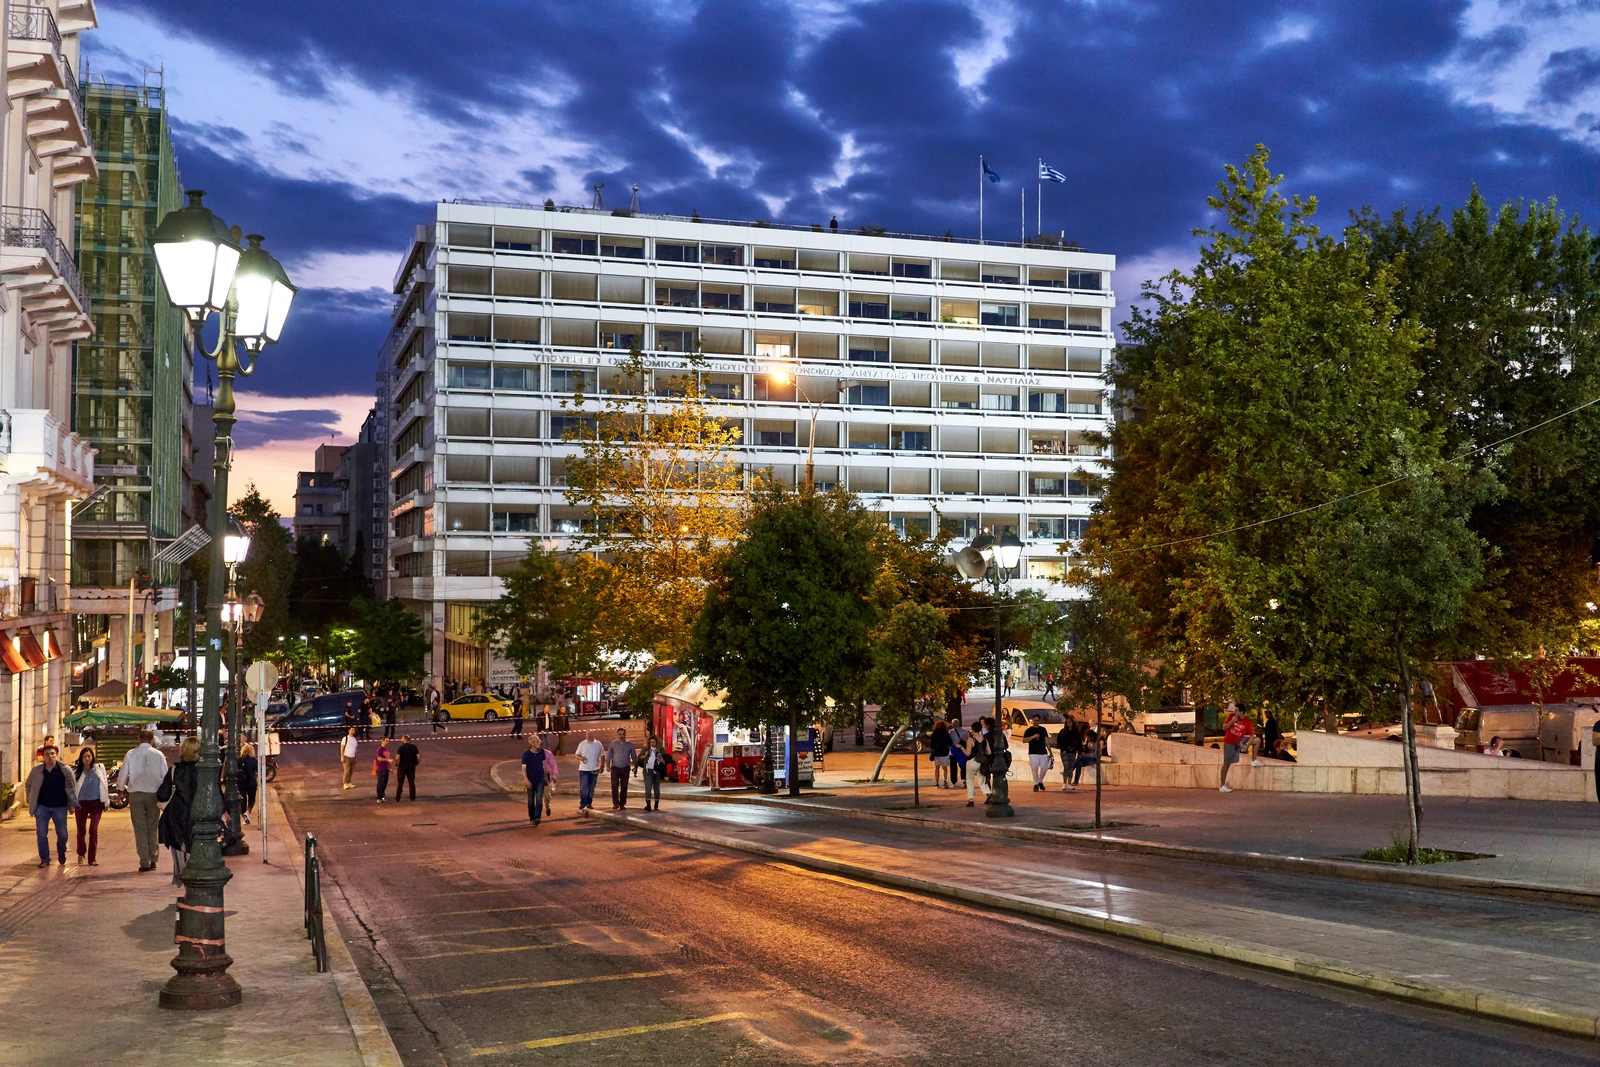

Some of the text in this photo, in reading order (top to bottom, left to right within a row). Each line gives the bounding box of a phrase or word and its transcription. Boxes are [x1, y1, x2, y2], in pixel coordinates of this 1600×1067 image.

[533, 353, 601, 365] ΥΠΟΥΡΓΕΙΟ
[608, 356, 688, 369] ΟΙΚΟΜΙΚΩ
[973, 375, 980, 383] &
[987, 375, 1042, 386] ΝΑΥΤΙΛΙΑΣ
[373, 463, 384, 578] ARETHUSA
